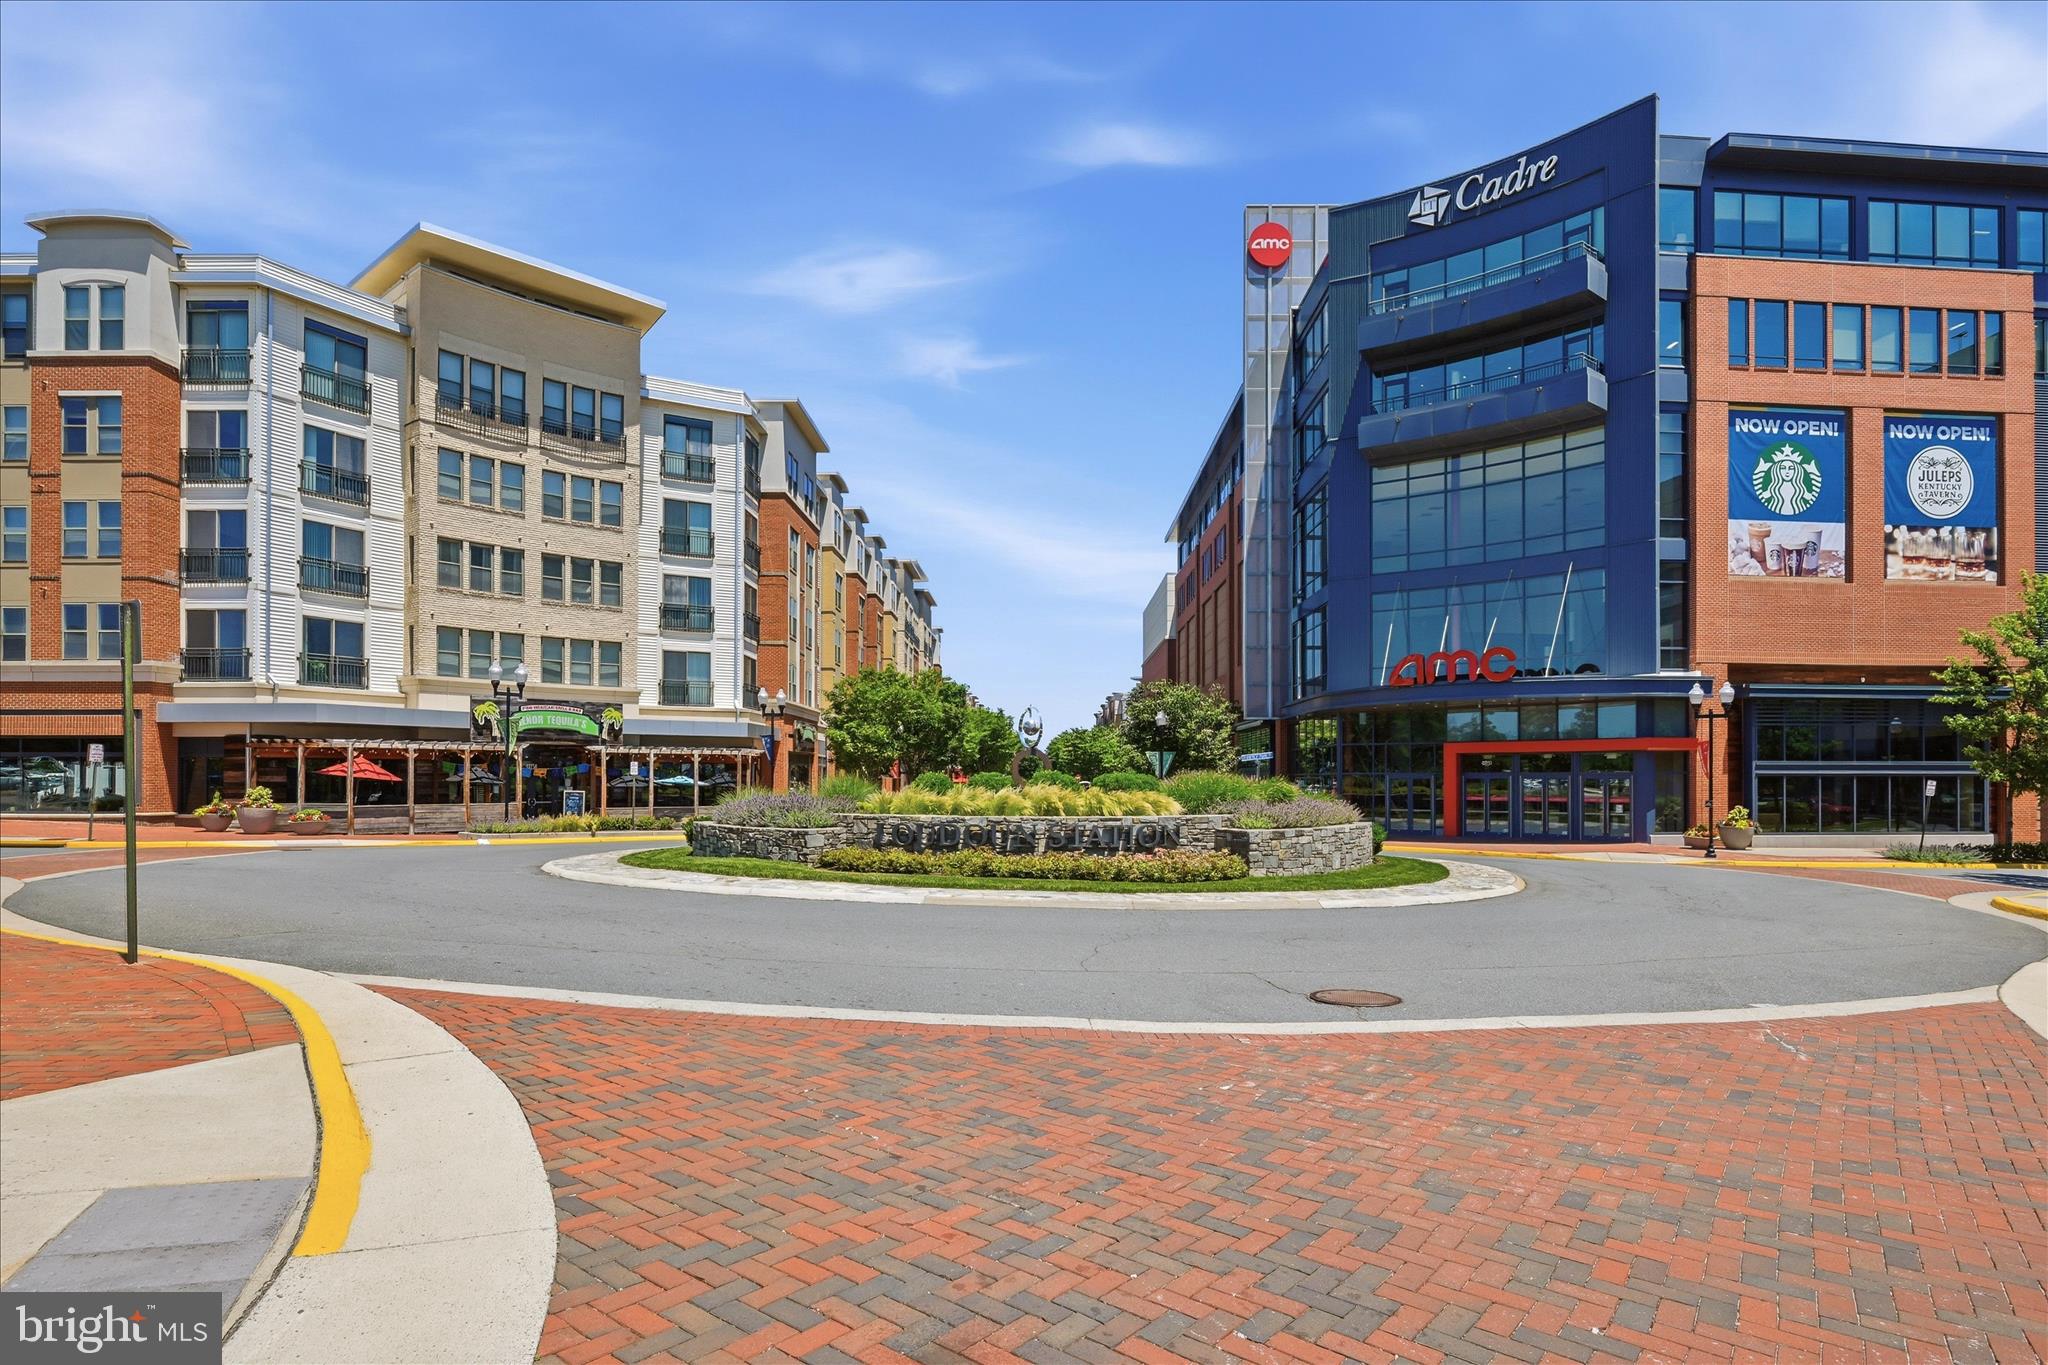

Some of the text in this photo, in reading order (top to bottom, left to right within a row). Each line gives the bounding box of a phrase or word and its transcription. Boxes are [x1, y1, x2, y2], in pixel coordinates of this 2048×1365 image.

[1455, 154, 1559, 212] Cadre
[1251, 238, 1290, 250] amc
[1735, 417, 1839, 437] NOW OPEN!
[1889, 423, 1991, 442] NOW OPEN!
[1918, 470, 1962, 482] JULEPS
[1918, 483, 1962, 491] KENTUCKY
[1923, 490, 1957, 498] TAVERN
[1388, 645, 1518, 688] amc
[547, 715, 587, 729] TEQUILA'S
[1048, 822, 1182, 848] STATION
